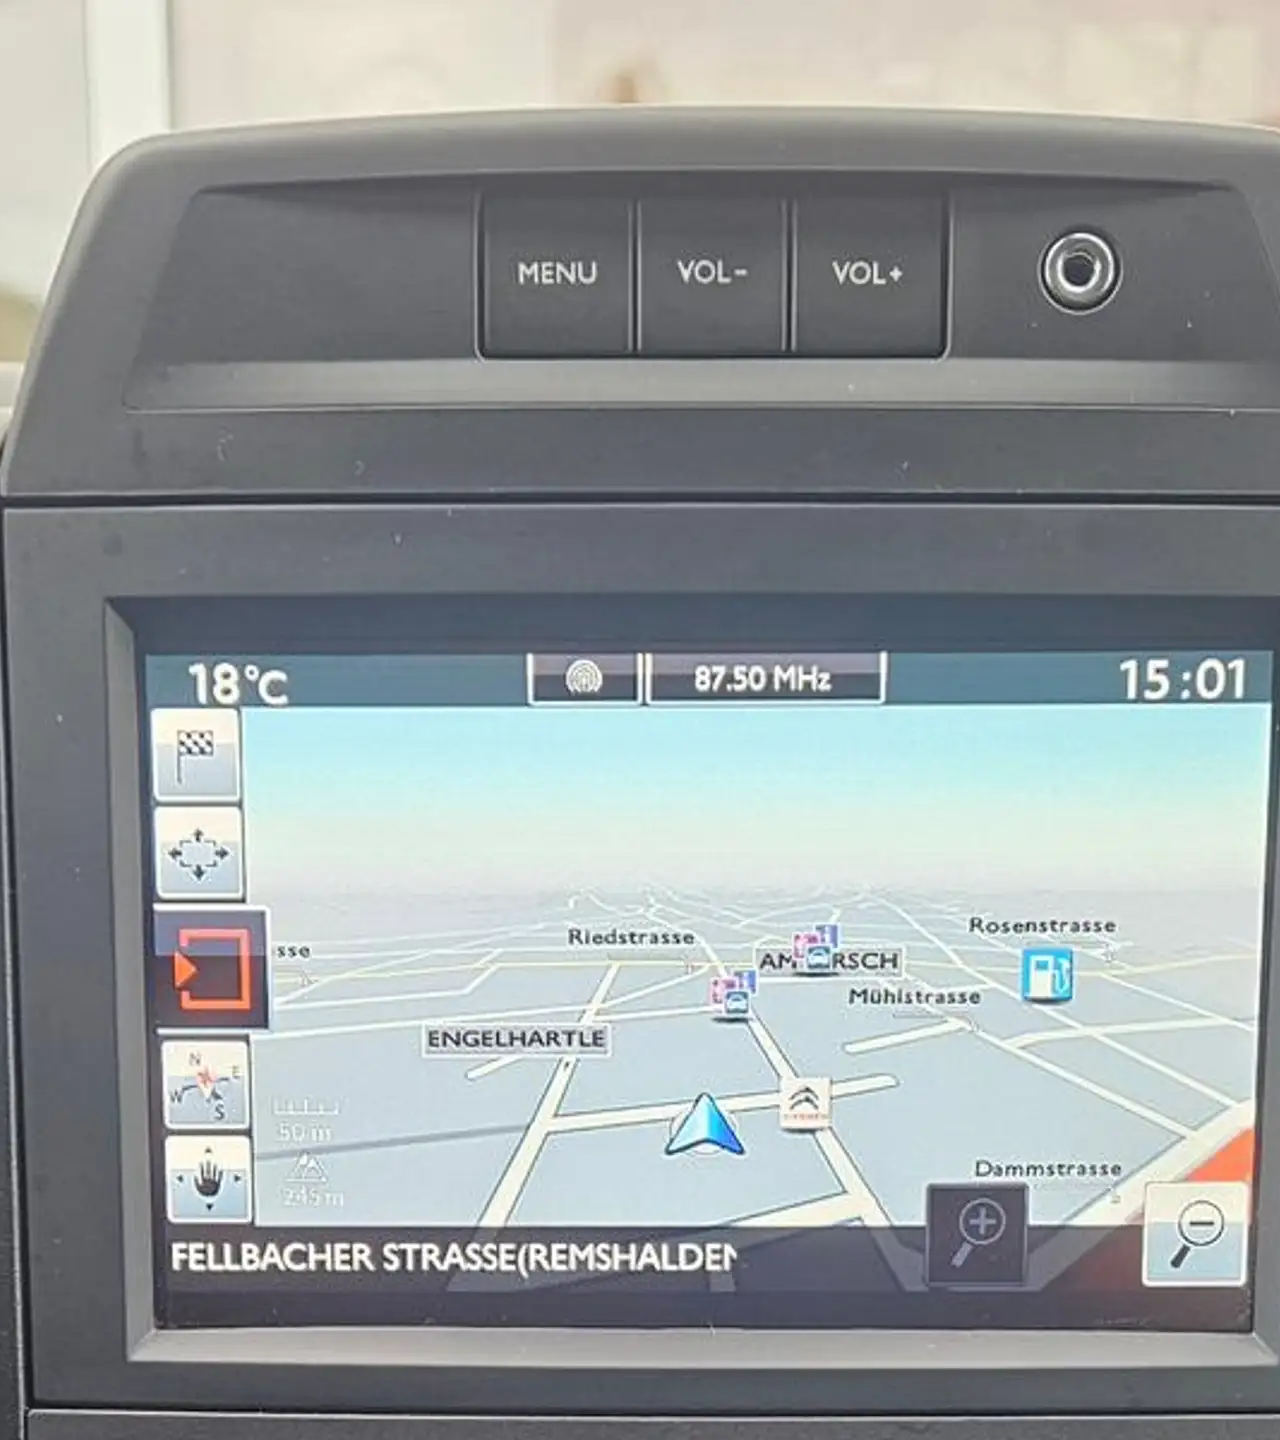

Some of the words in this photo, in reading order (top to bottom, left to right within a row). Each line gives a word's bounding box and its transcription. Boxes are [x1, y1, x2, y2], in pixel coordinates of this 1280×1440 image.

[517, 261, 598, 285] MENU
[677, 260, 748, 284] VOL-
[832, 261, 903, 286] VOL+
[188, 662, 289, 705] 18°C
[694, 664, 766, 693] 87.50
[773, 664, 832, 692] MHz
[1119, 658, 1246, 701] 15:01
[567, 927, 695, 946] Riedstrasse
[969, 915, 1117, 934] Rosenstrasse
[848, 987, 982, 1006] Mühlstrasse
[426, 1029, 606, 1050] ENGELHARTLE
[974, 1160, 1123, 1179] Dammstrasse
[171, 1243, 375, 1271] FELLBACHER
